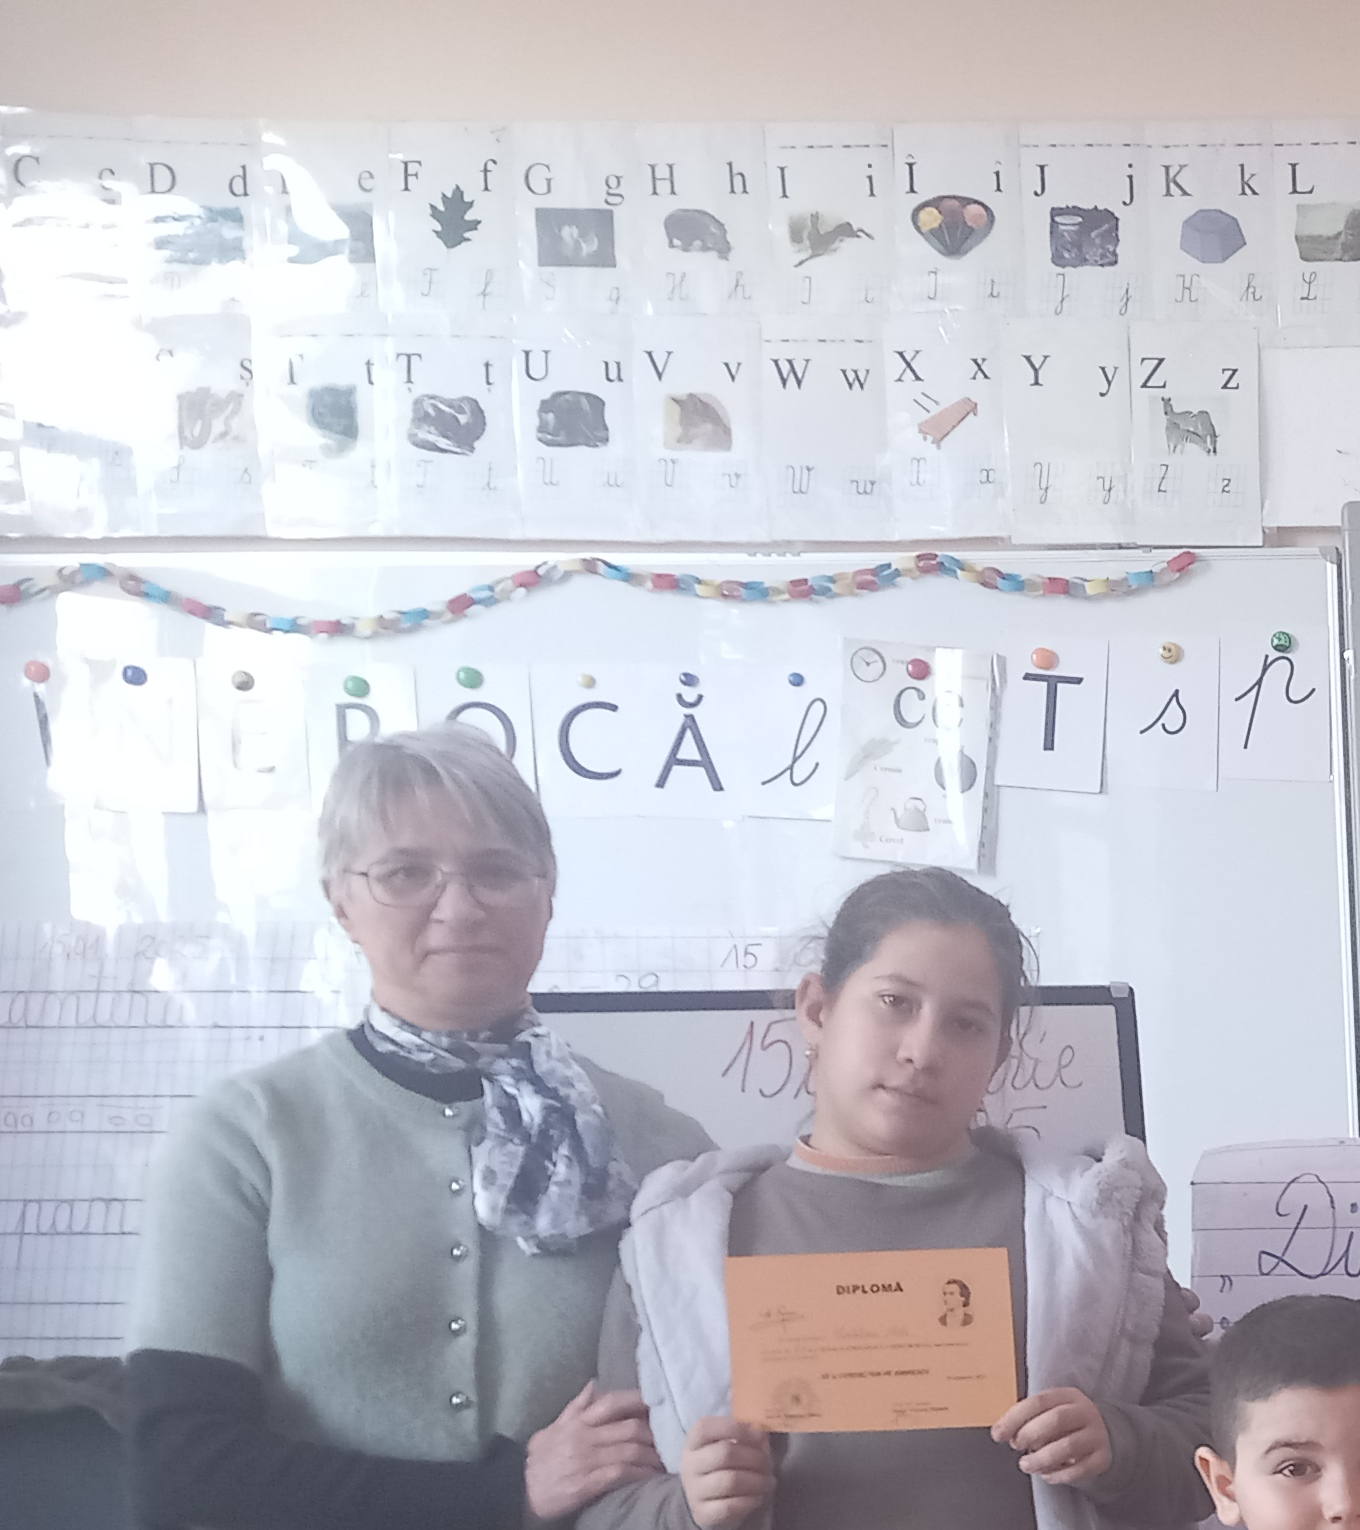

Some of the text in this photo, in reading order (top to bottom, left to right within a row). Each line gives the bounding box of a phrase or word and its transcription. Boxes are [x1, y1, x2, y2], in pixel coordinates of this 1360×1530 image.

[13, 156, 39, 187] C
[148, 162, 177, 194] D
[229, 165, 249, 197] d
[358, 169, 375, 192] e
[400, 159, 497, 192] F f
[524, 163, 624, 205] G g
[647, 161, 749, 196] H h
[777, 163, 876, 198] I i
[905, 154, 1003, 194] Î î
[1034, 164, 1134, 206] J j
[1161, 164, 1259, 196] K k
[1289, 163, 1315, 194] L
[522, 350, 624, 382] U u
[644, 350, 742, 382] V v
[771, 358, 870, 392] W w
[894, 350, 992, 383] X x
[1022, 355, 1119, 396] Y y
[1140, 358, 1239, 390] Z z
[1022, 671, 1084, 752] T
[557, 701, 623, 781] C
[654, 692, 724, 792] Ă
